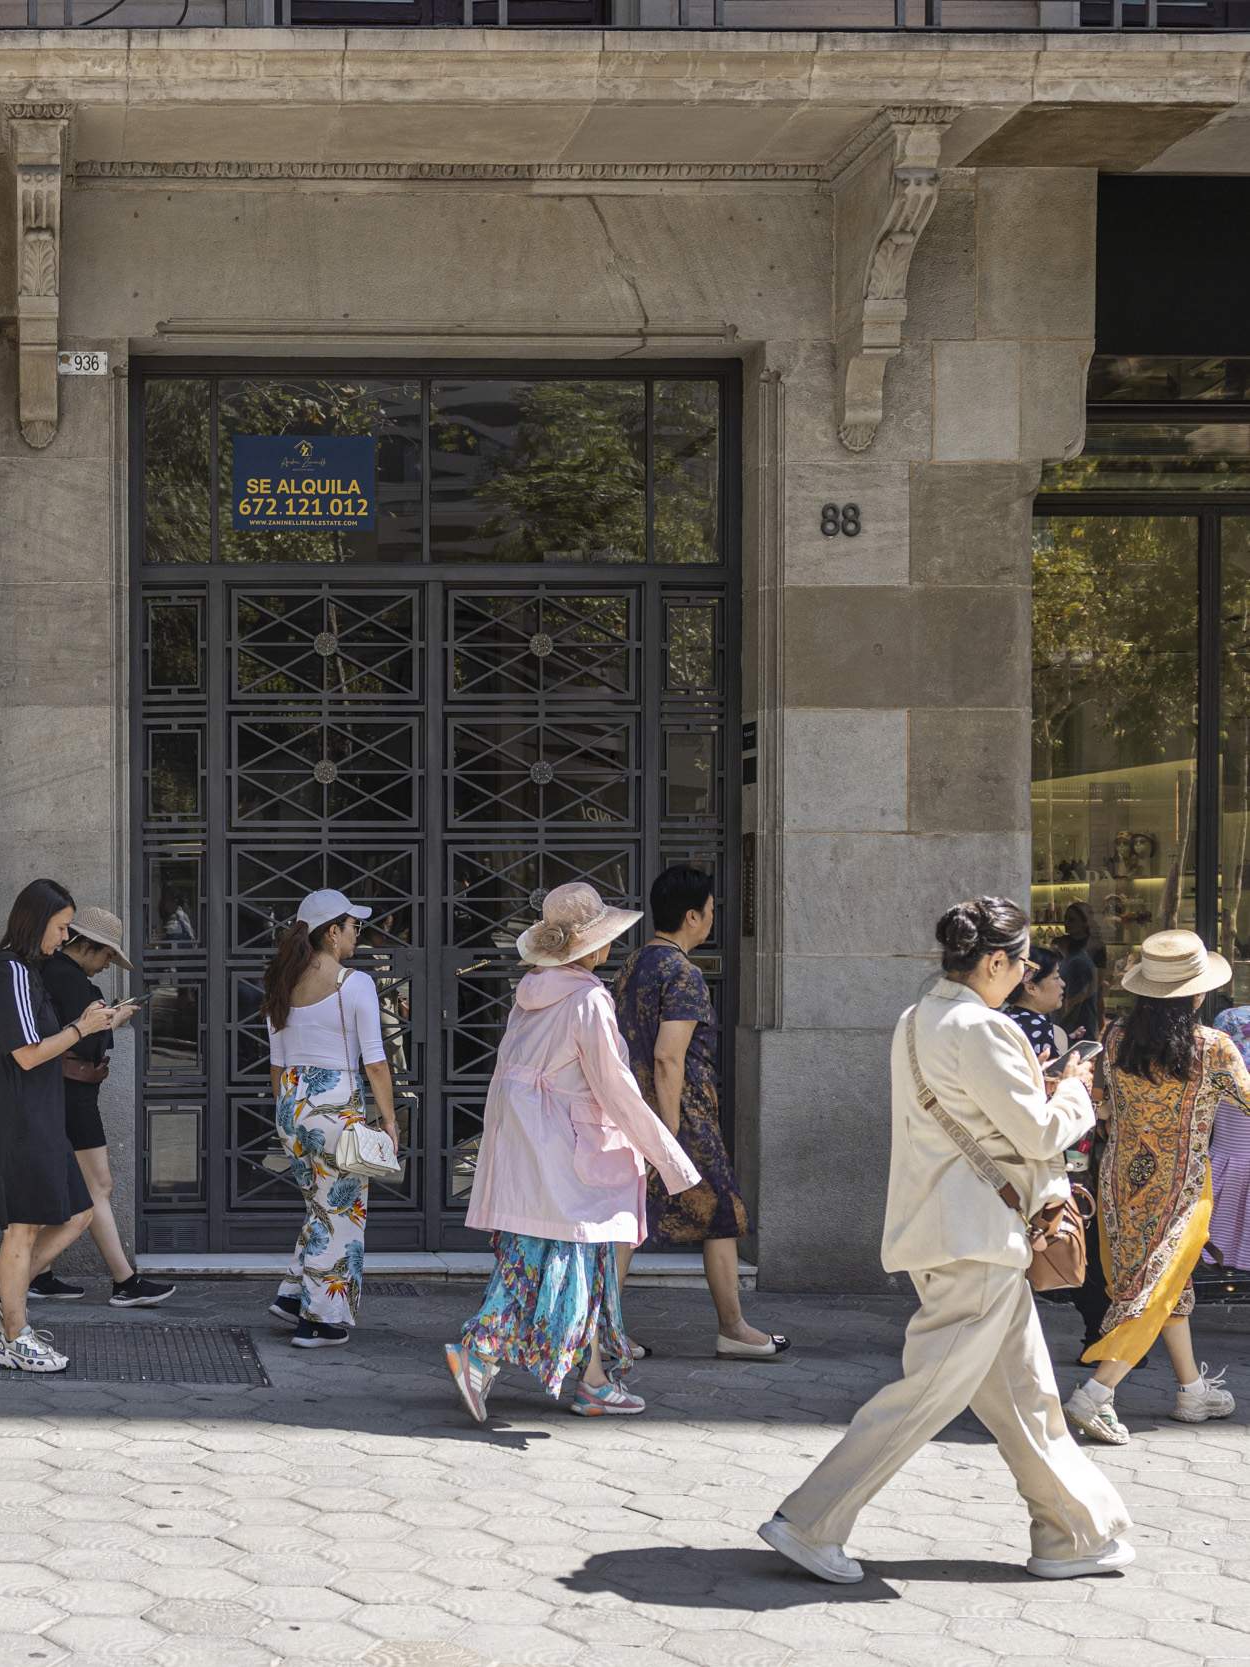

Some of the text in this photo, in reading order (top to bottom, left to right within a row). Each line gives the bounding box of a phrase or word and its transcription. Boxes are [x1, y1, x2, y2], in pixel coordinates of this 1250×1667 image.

[74, 355, 99, 371] 936
[246, 478, 361, 495] SE ALQUILA
[238, 498, 368, 516] 672.121.012
[820, 503, 861, 537] 88
